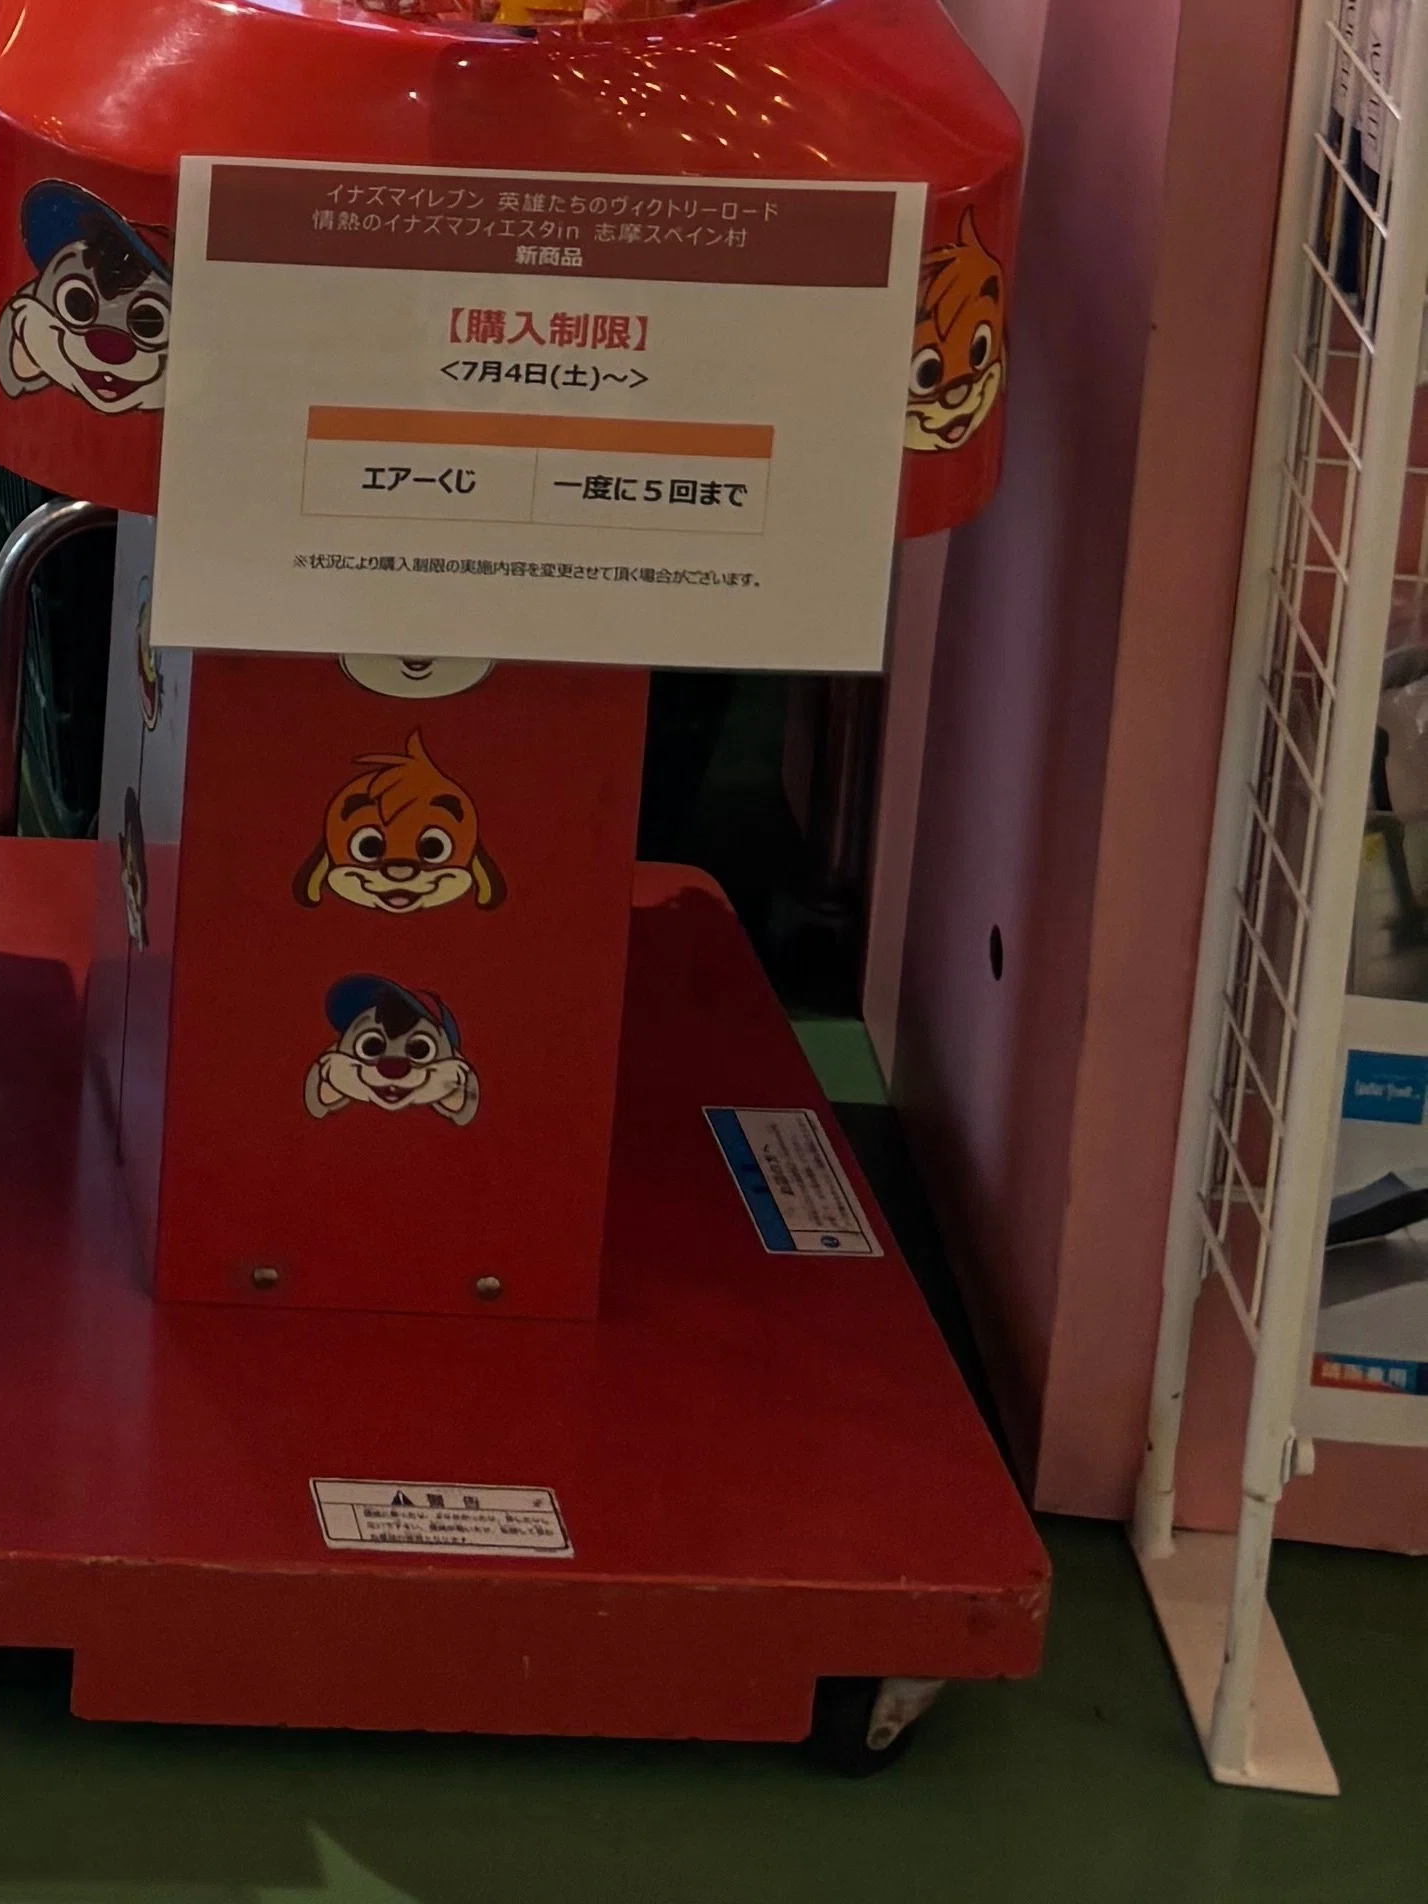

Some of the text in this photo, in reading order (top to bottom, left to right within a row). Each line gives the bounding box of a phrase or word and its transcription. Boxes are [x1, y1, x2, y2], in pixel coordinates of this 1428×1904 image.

[326, 184, 780, 223] イナズマイレブン 英雄たちのヴィクトリーロード
[593, 223, 748, 249] 志摩スペイン村
[515, 245, 584, 268] 新商品
[445, 305, 650, 353] 【購入制限】
[361, 465, 477, 496] エアーくじ
